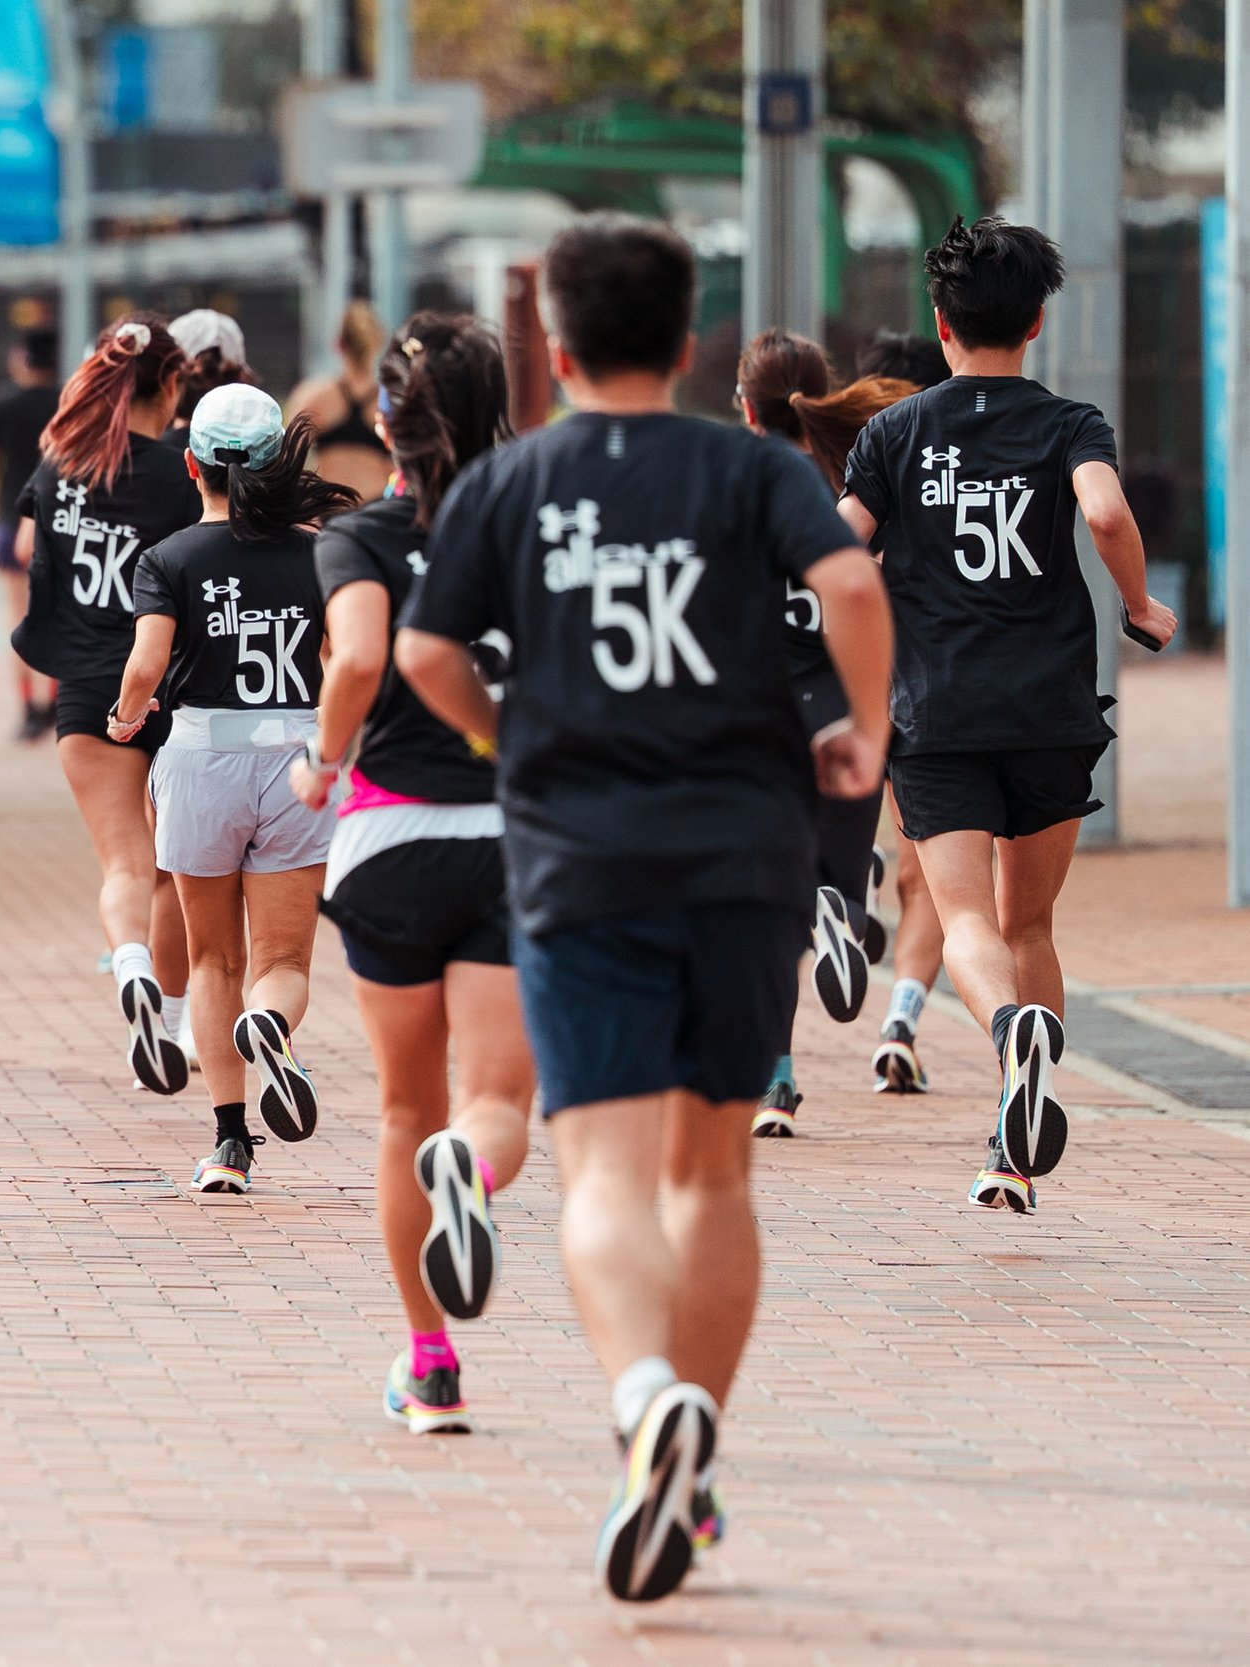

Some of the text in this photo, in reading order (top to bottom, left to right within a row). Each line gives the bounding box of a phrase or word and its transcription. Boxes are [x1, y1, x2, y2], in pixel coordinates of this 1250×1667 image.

[72, 530, 141, 613] 5K
[953, 489, 1043, 582] 5K
[236, 618, 311, 705] 5K
[591, 555, 719, 693] 5K
